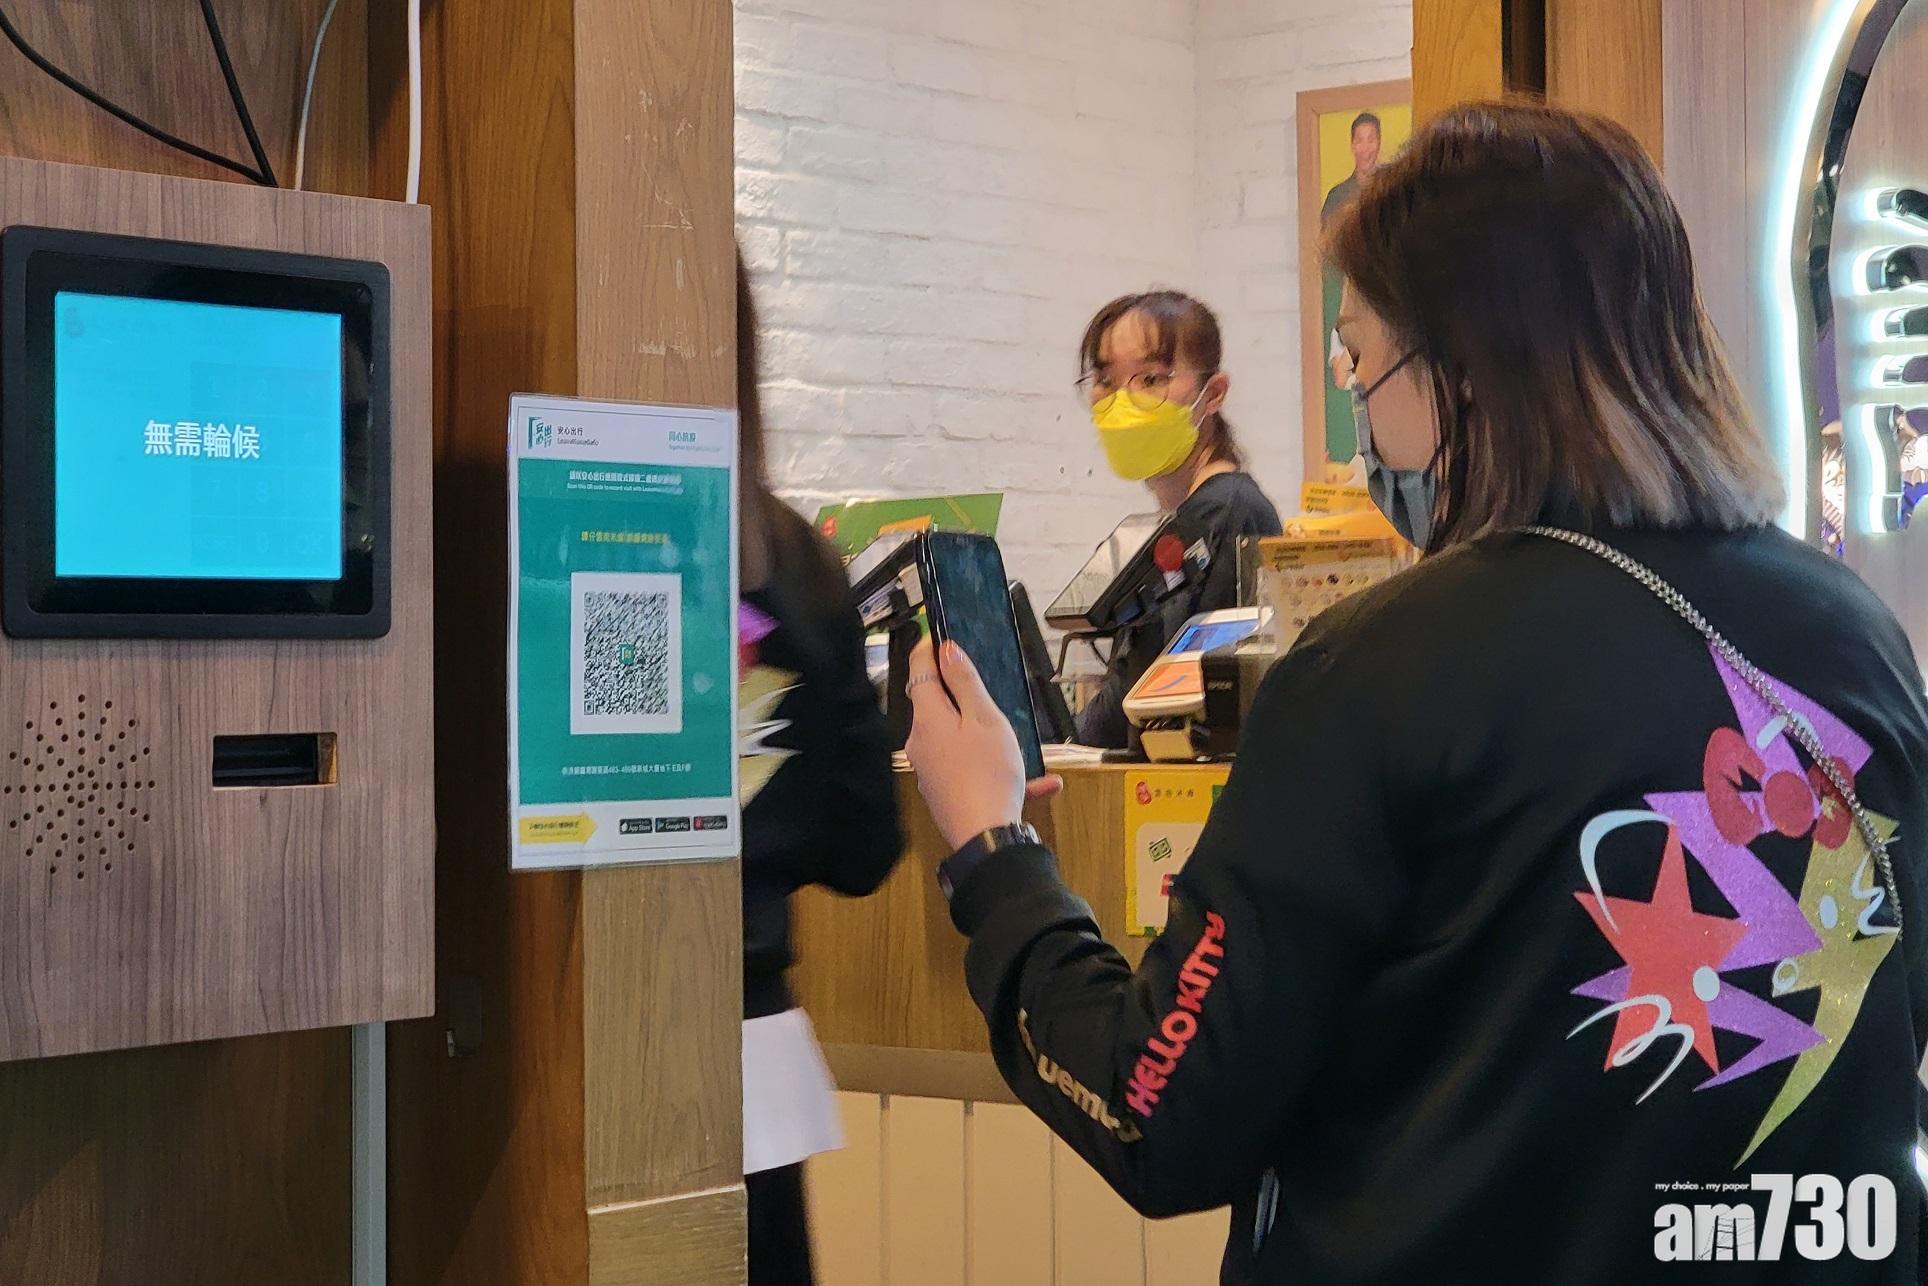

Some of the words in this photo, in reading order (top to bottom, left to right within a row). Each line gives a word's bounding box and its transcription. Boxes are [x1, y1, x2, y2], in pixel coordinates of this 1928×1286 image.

[144, 419, 260, 459] 無需輪候
[557, 426, 584, 437] 安心出行
[628, 823, 638, 832] App
[1125, 1010, 1198, 1118] HELLO
[1175, 910, 1227, 1014] KITTY
